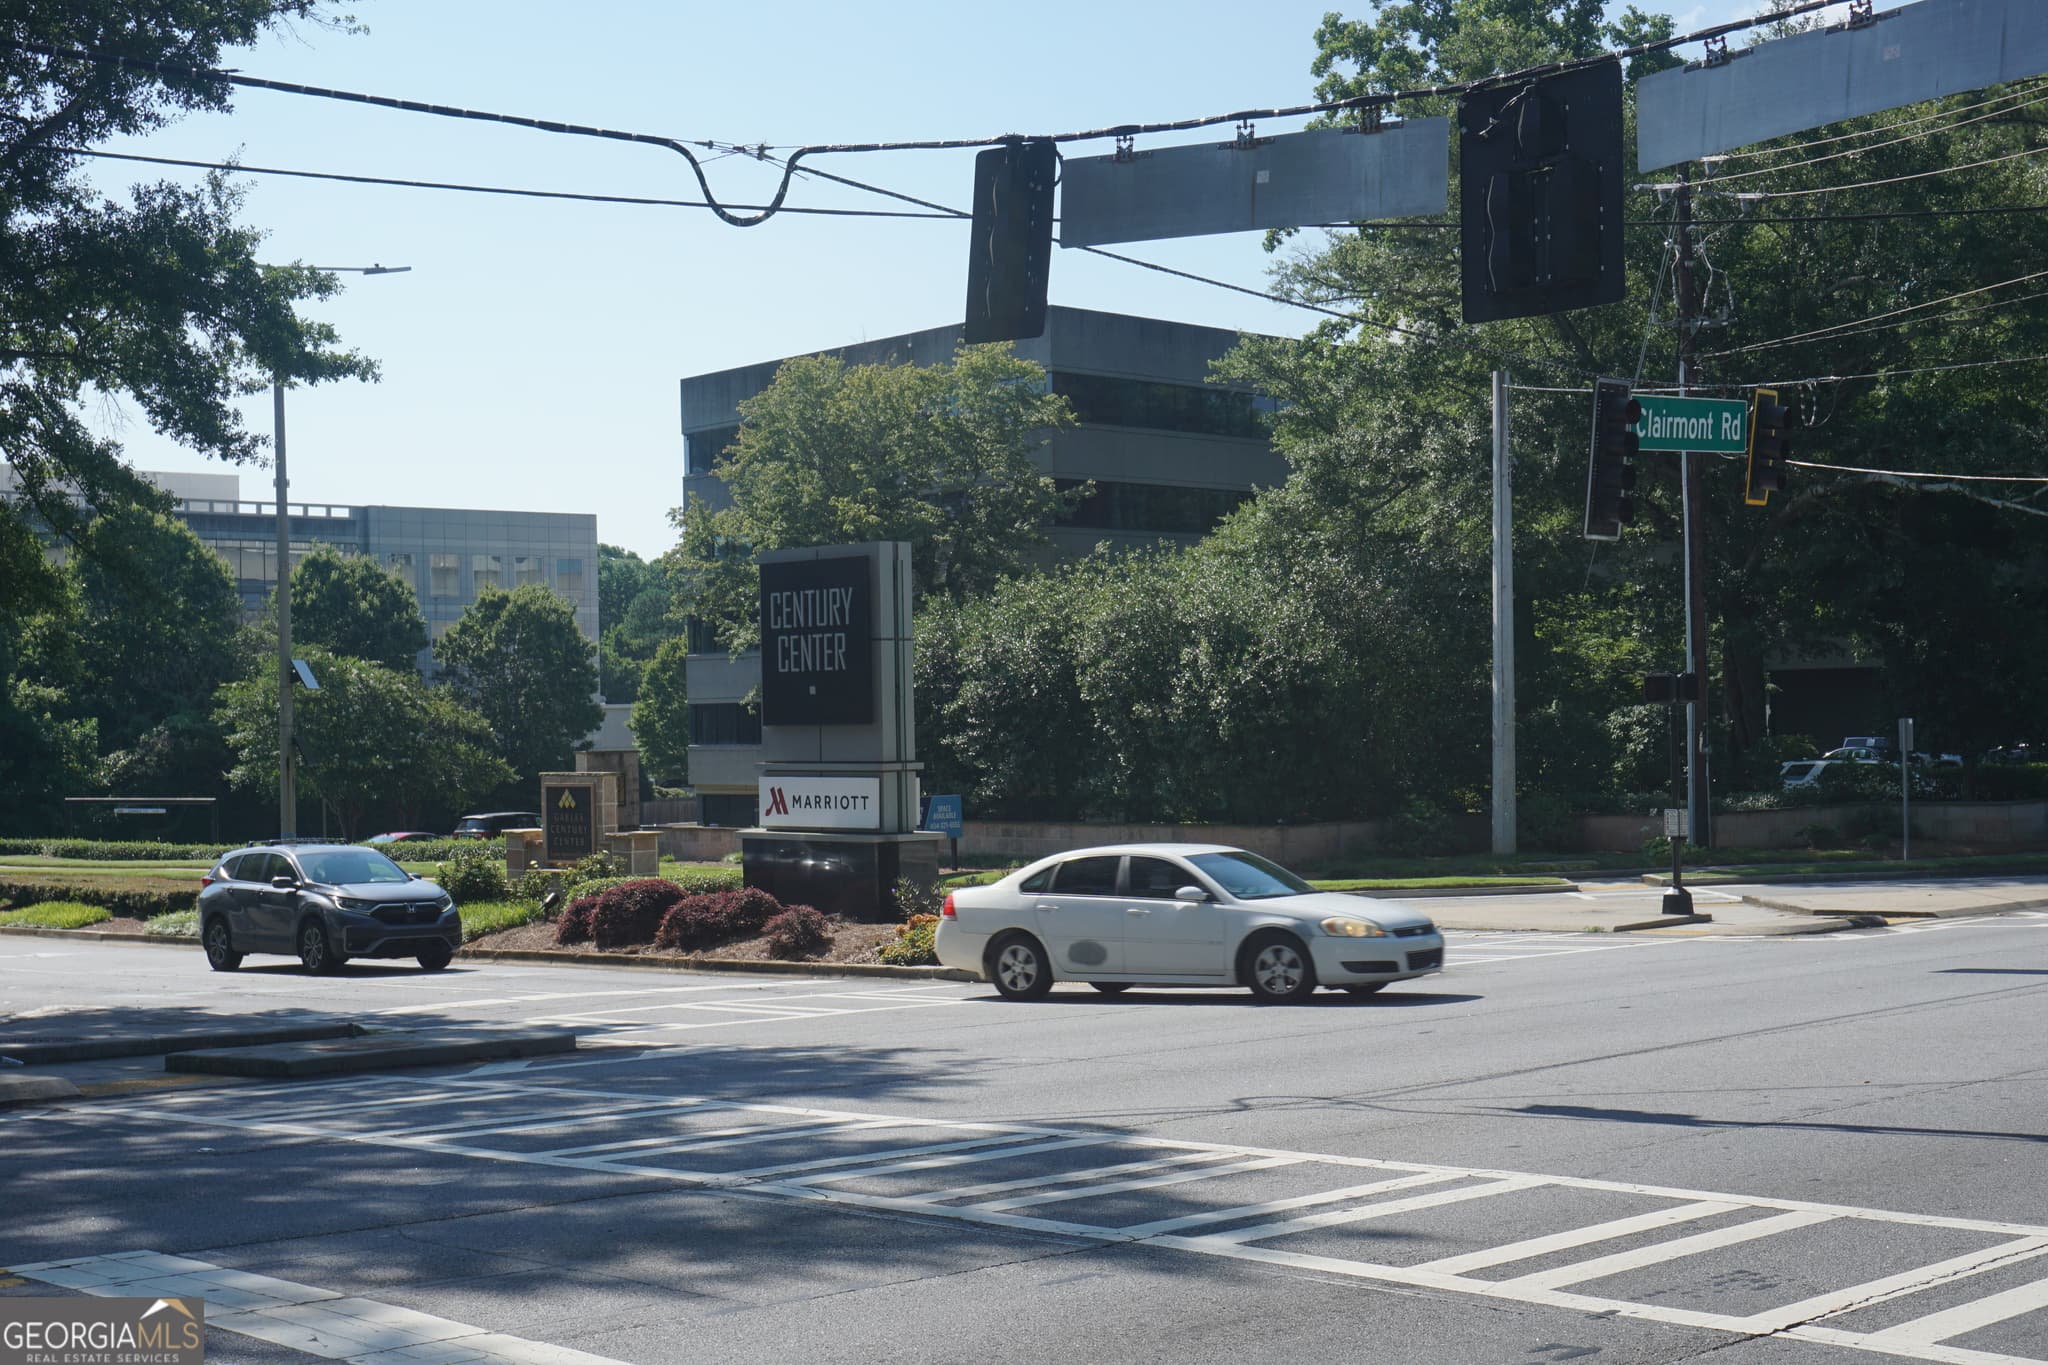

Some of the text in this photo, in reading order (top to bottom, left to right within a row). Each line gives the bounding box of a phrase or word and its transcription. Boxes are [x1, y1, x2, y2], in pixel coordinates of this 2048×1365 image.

[1636, 407, 1741, 441] Clairmont Rd
[770, 587, 853, 629] CENTURY
[778, 632, 846, 673] CENTER
[792, 794, 869, 811] MARRIOTT
[551, 824, 588, 834] CENTURY
[553, 836, 585, 847] CENTER
